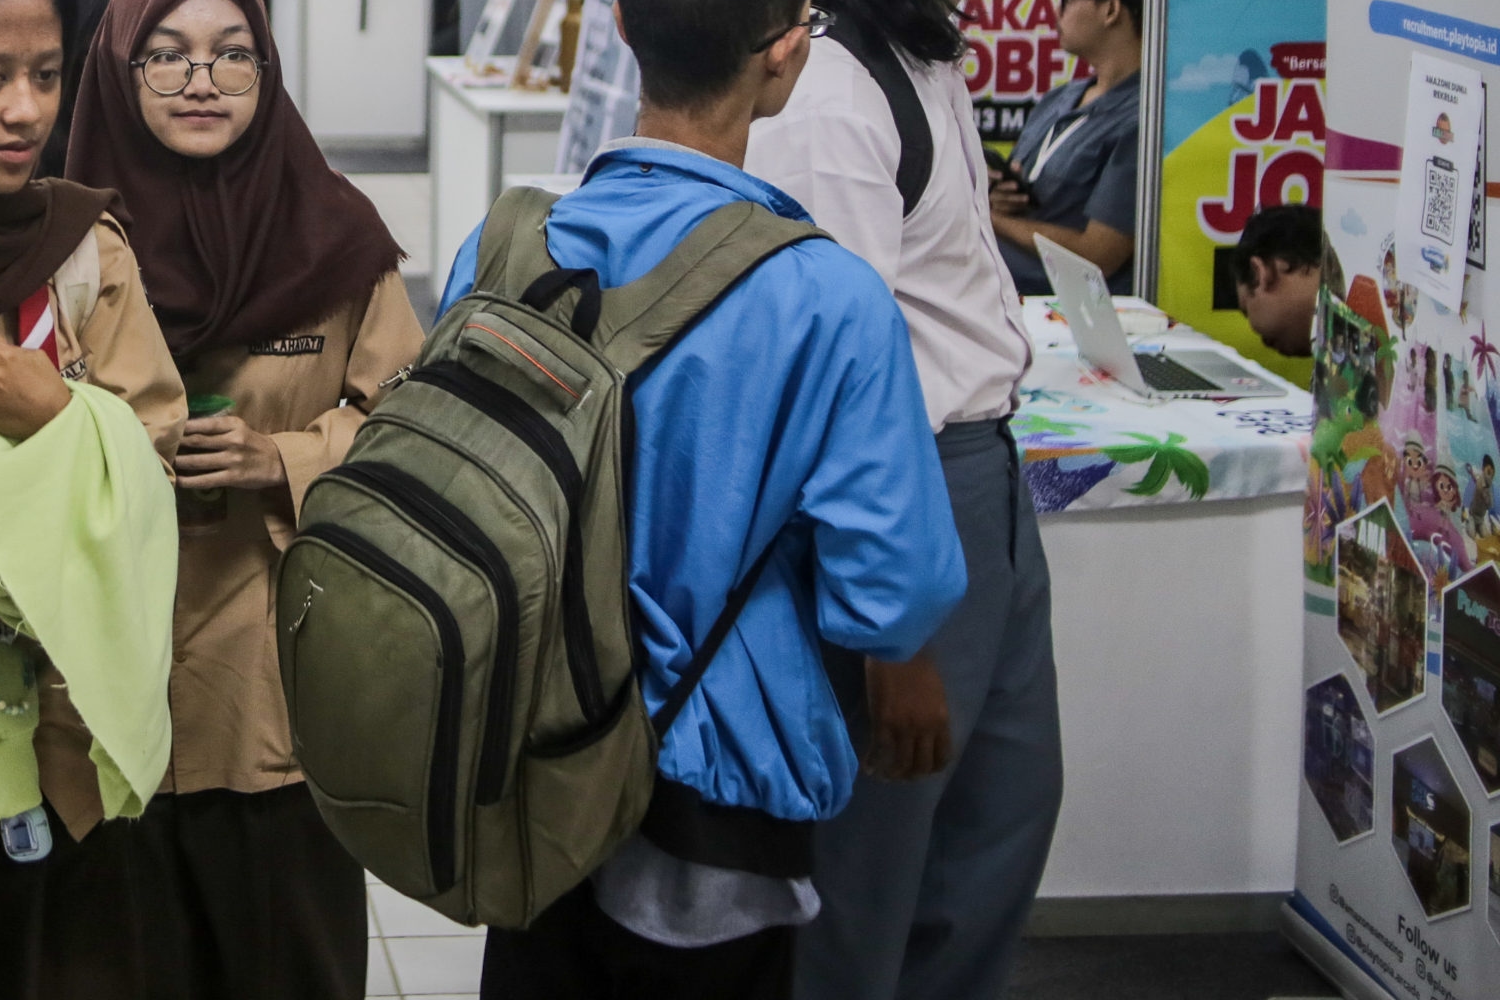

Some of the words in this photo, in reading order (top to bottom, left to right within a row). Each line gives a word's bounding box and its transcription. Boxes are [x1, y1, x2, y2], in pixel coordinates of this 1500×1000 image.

[1403, 17, 1498, 56] recruitment.playtopia.id
[1397, 913, 1440, 966] Follow
[1443, 957, 1458, 982] us
